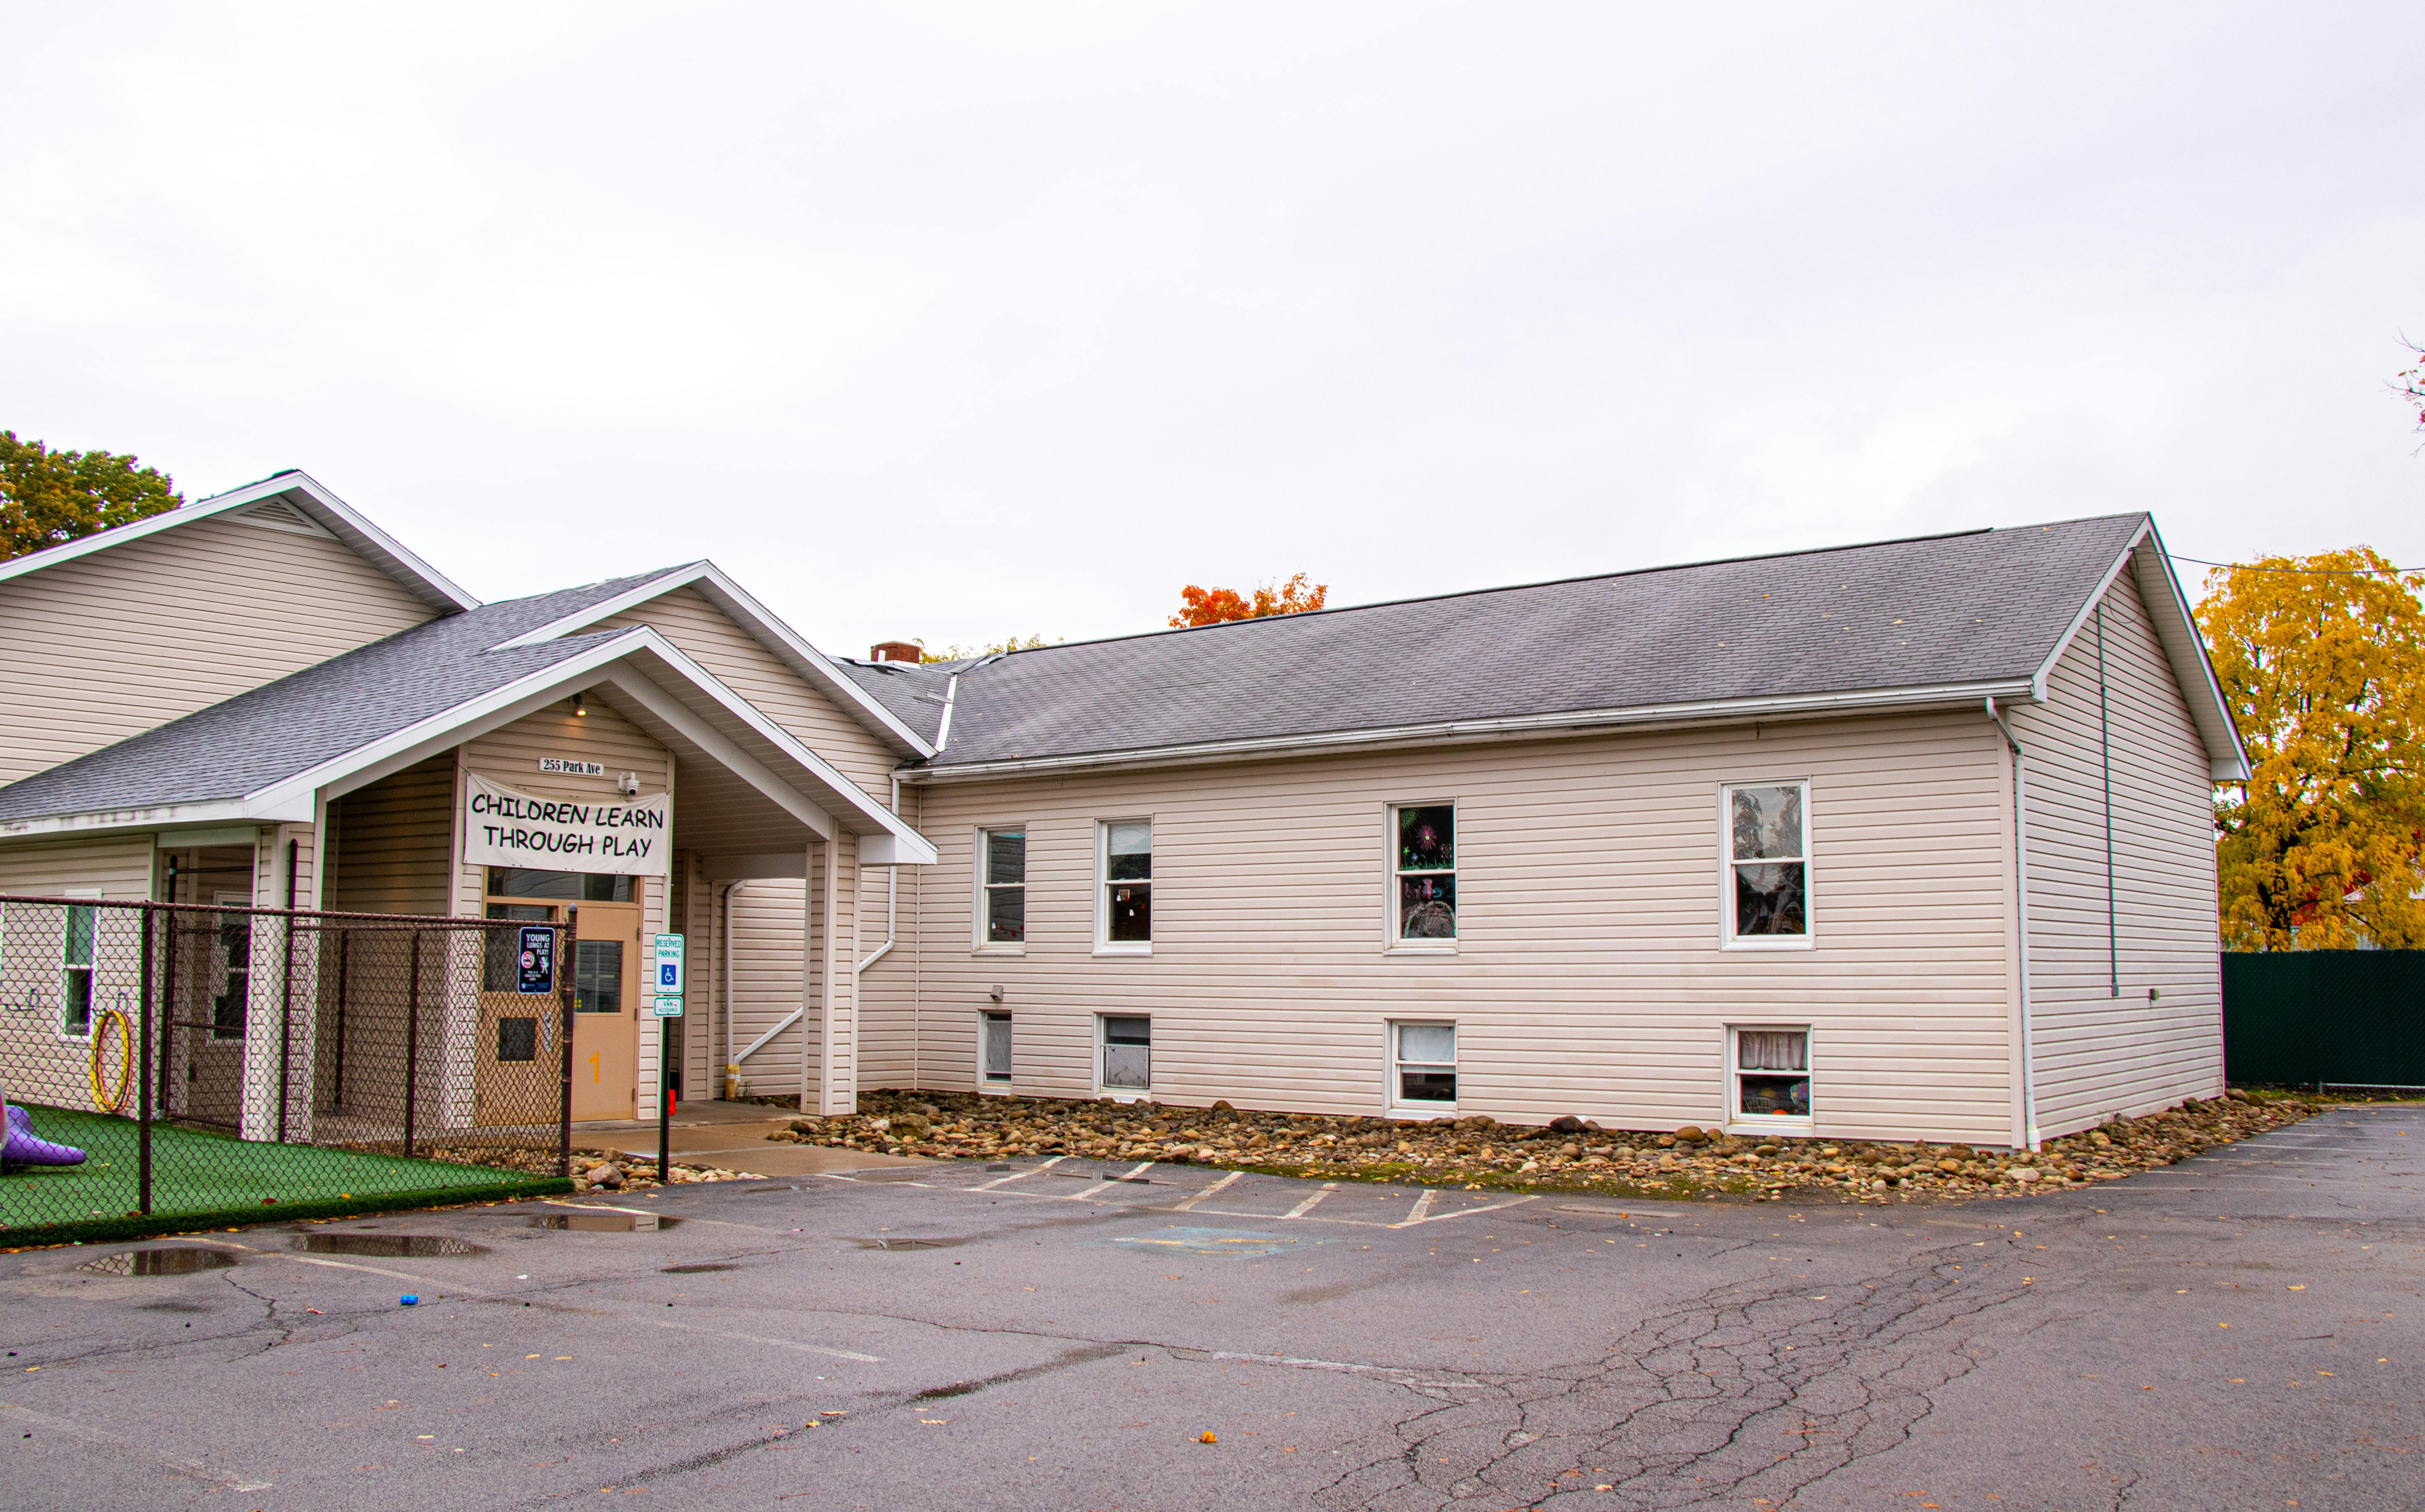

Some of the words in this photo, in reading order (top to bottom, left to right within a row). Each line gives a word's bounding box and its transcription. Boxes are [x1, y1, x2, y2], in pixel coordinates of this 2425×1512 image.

[544, 759, 560, 771] 255
[563, 761, 584, 773] Park
[586, 763, 600, 774] Ave
[472, 794, 589, 824] CHILDREN
[595, 807, 663, 829] LEARN
[483, 825, 594, 854] THROUGH
[602, 835, 652, 858] PLAY
[526, 934, 550, 942] YOUNG
[657, 939, 681, 948] RESERVED
[588, 1051, 599, 1083] 1
